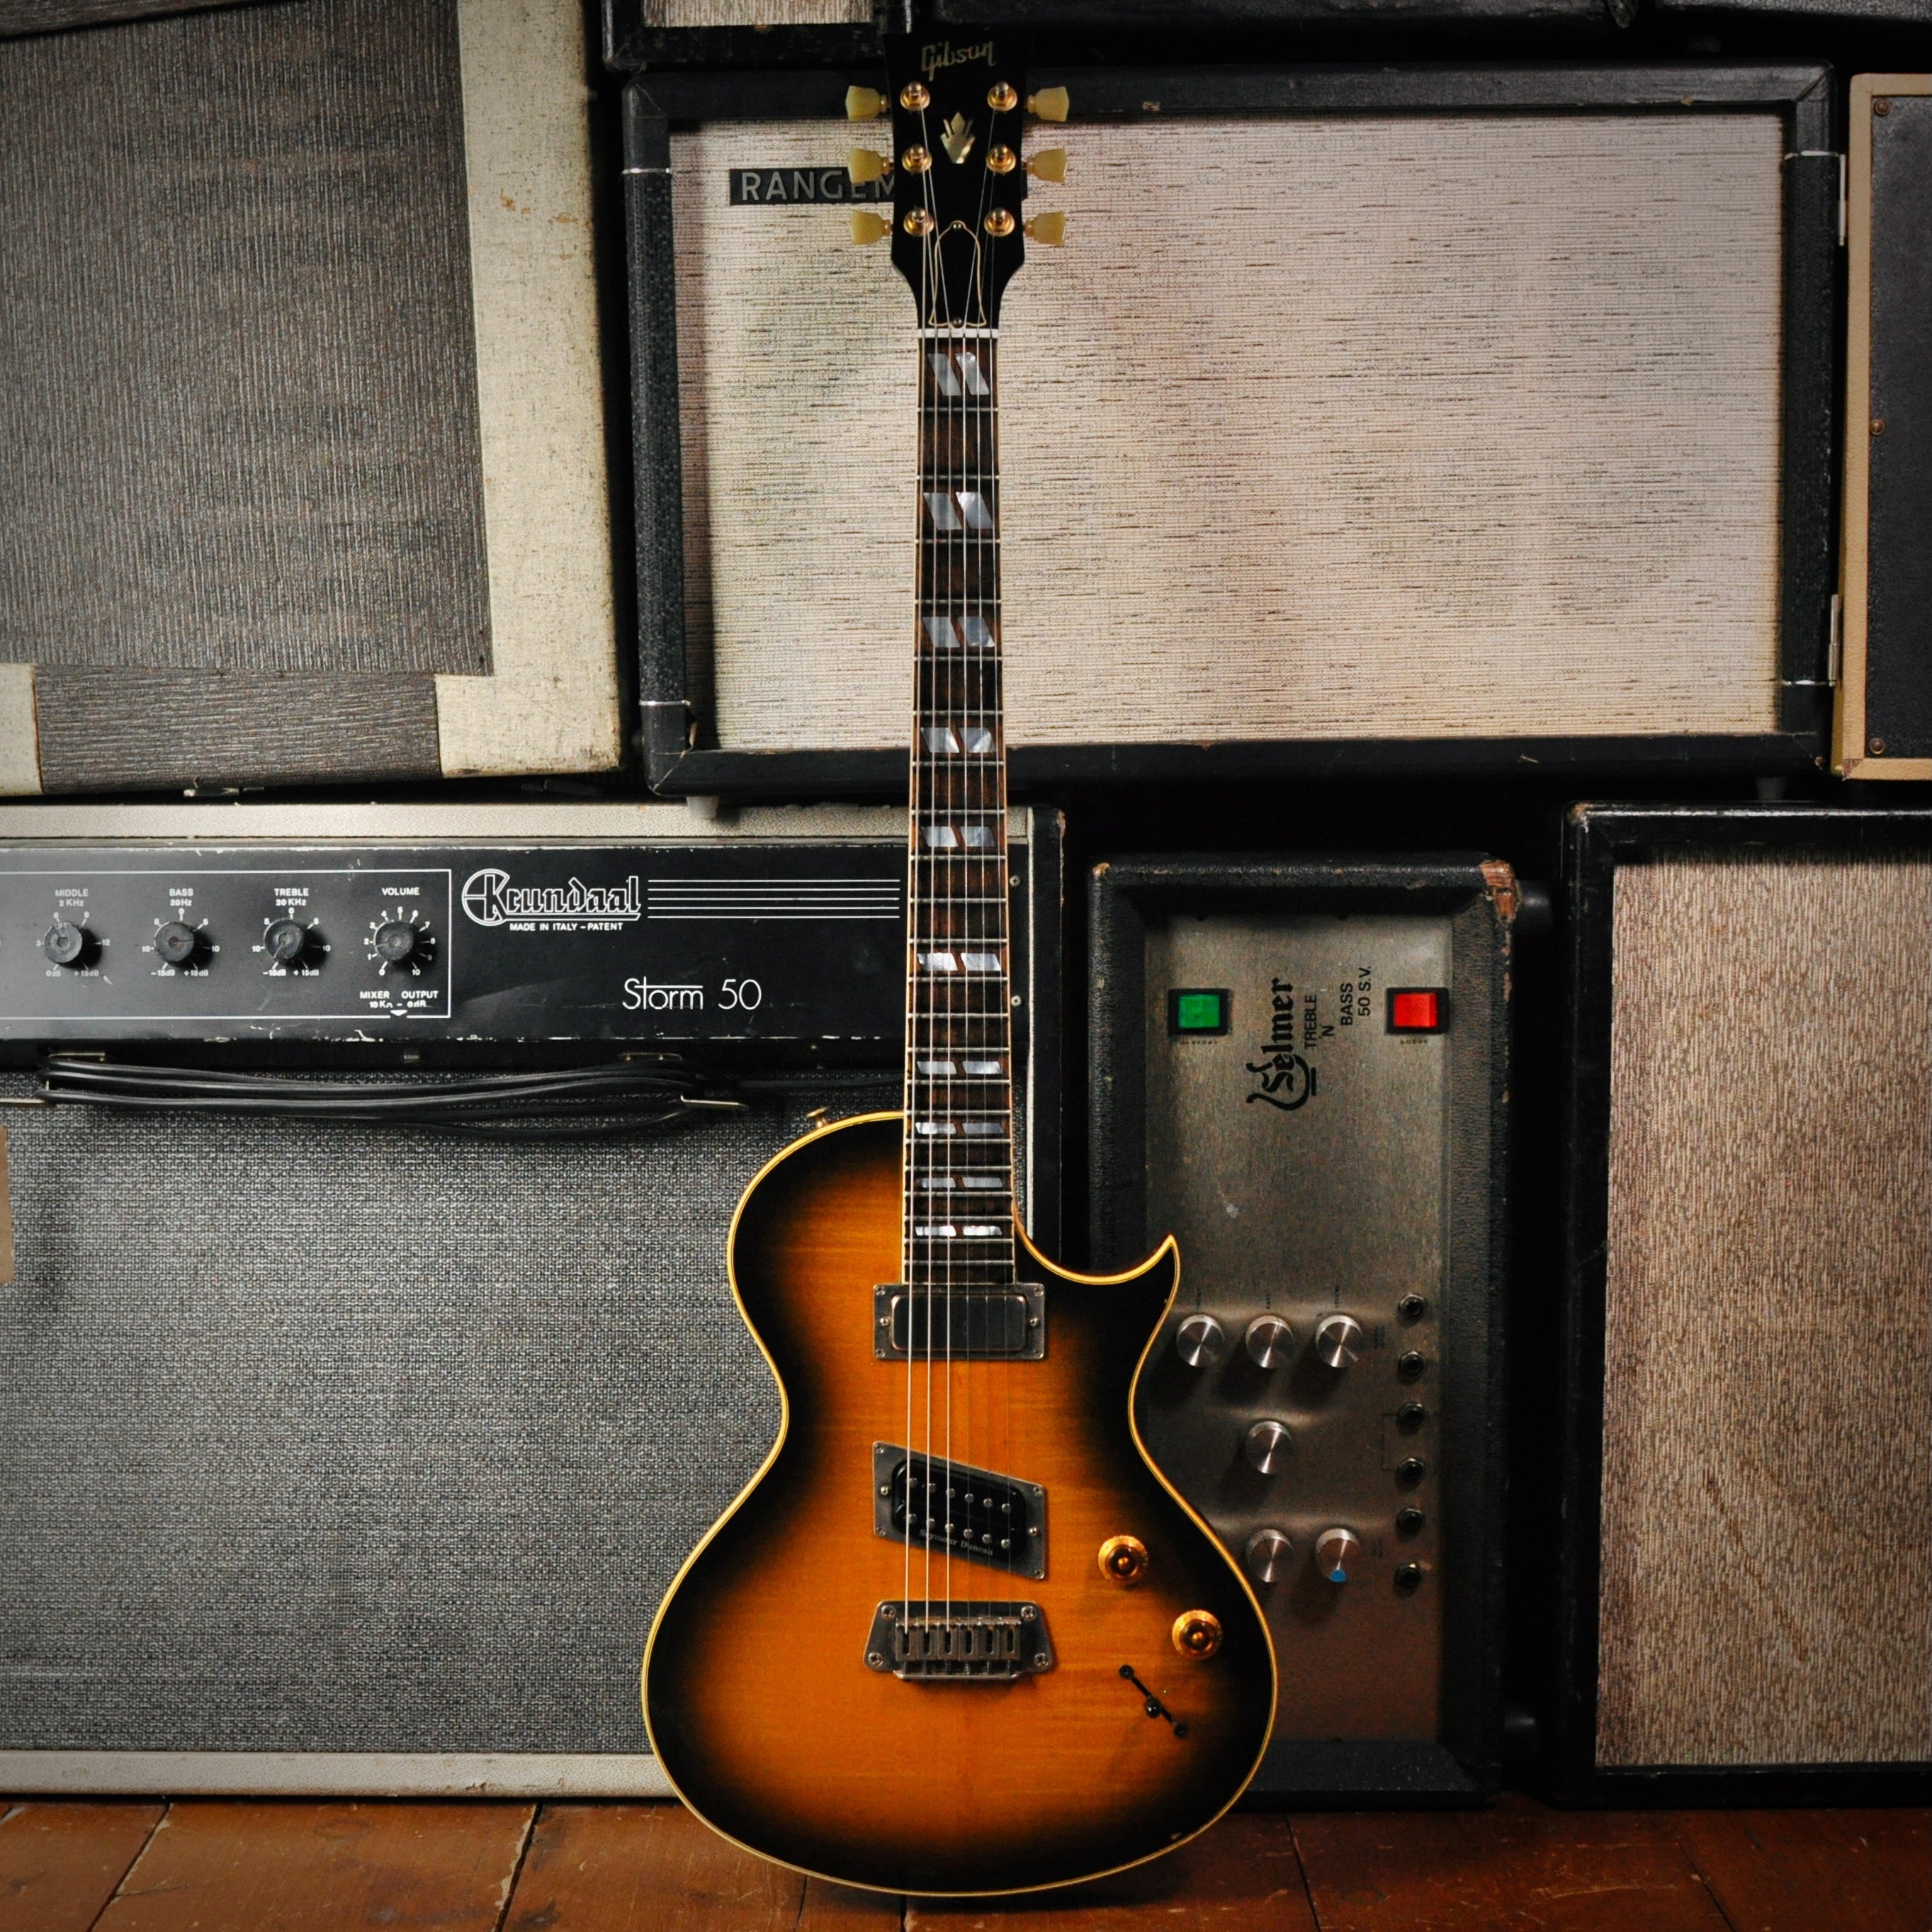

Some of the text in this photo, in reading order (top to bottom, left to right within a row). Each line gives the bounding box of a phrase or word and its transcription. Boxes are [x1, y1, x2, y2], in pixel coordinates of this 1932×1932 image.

[921, 41, 996, 81] Gibson
[55, 888, 89, 897] MIDDLE
[66, 898, 84, 907] KHz
[169, 888, 193, 897] BASS
[273, 888, 310, 896] TREBLE
[382, 887, 420, 896] VOLUME
[461, 868, 641, 927] Krundaal
[509, 922, 536, 931] MADE
[359, 990, 439, 999] MIXER OUTPUT
[622, 976, 762, 1010] Storm 50
[1340, 983, 1353, 1026] BASS
[1357, 966, 1372, 1017] 50 S.V.
[1304, 995, 1317, 1049] TREBLE
[1245, 977, 1311, 1111] Selmer
[920, 1529, 993, 1556] Symour Duncan
